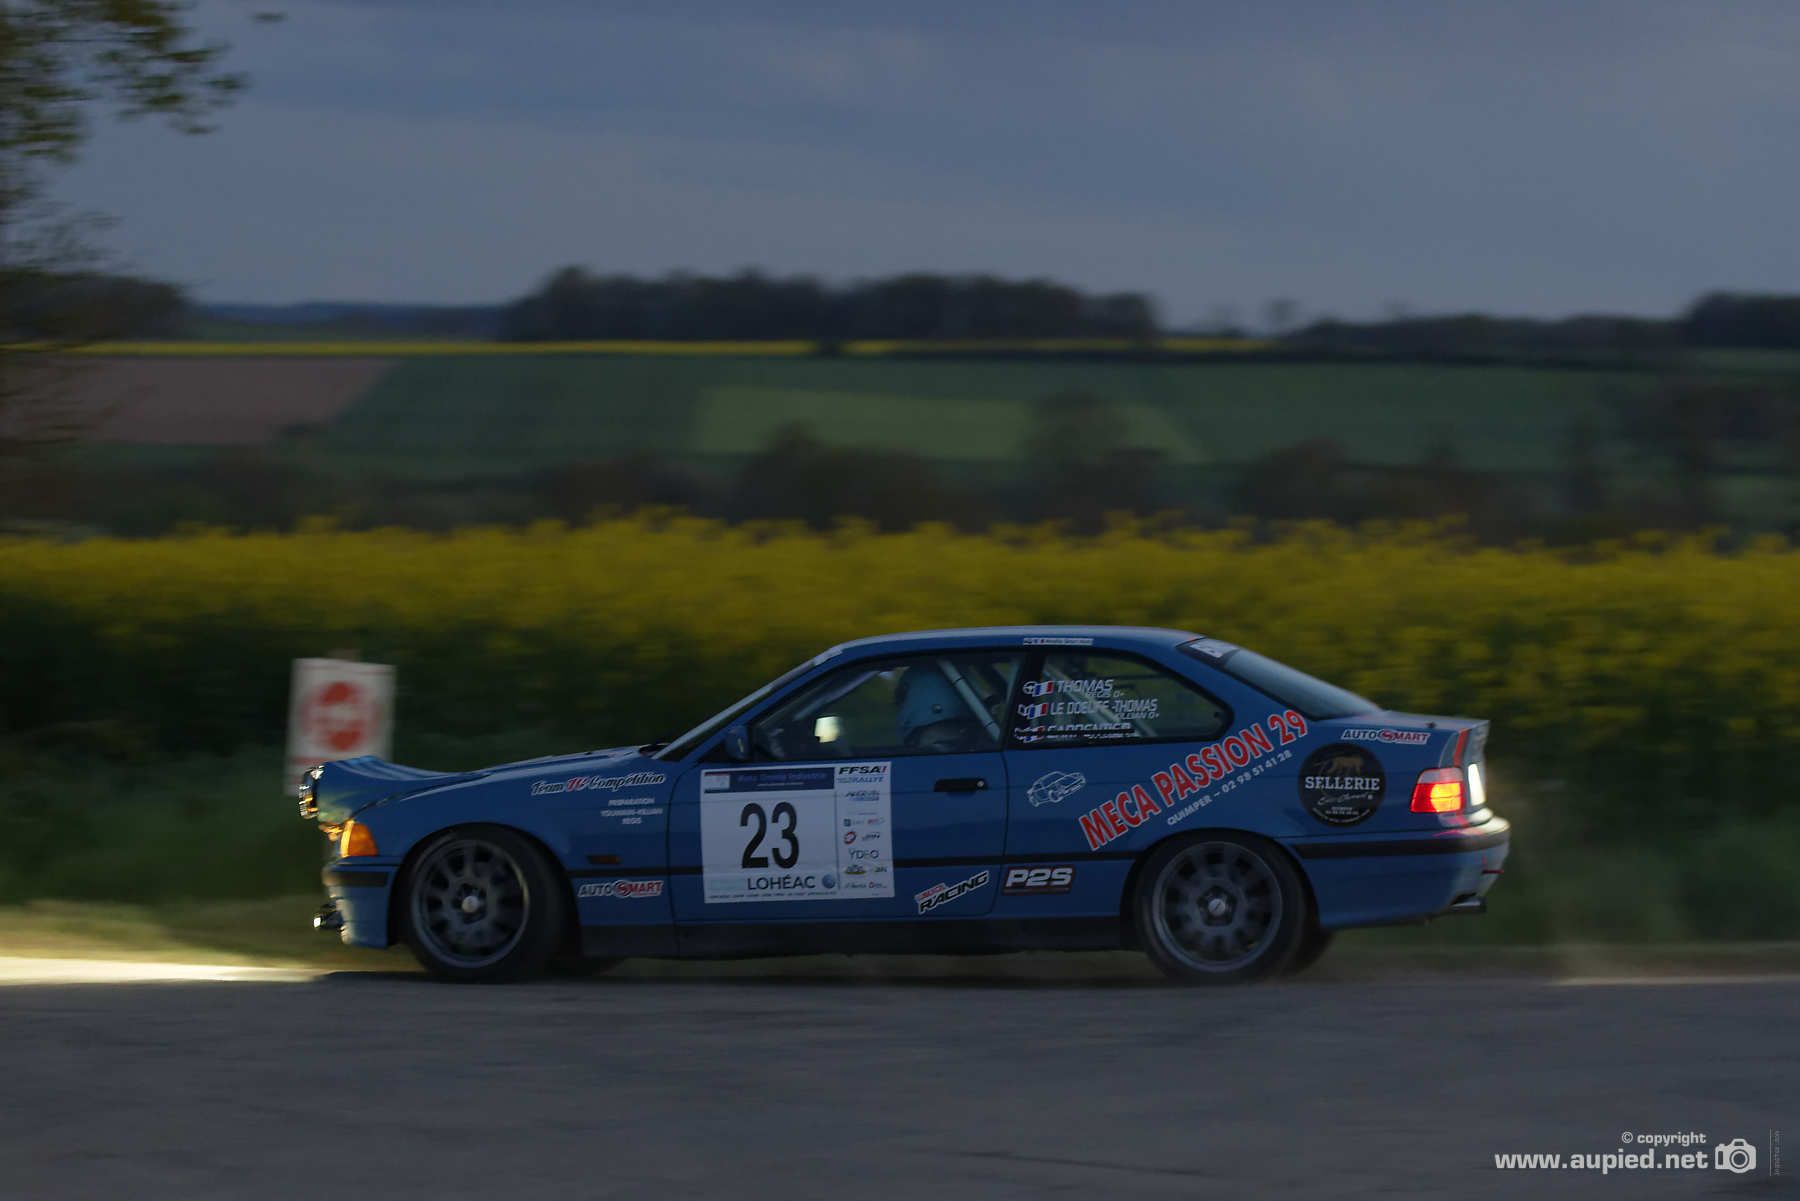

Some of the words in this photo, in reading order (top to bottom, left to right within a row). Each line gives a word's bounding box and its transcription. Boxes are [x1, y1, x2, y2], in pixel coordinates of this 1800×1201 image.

[1058, 679, 1114, 693] THOMAS
[1050, 701, 1065, 715] LE
[532, 780, 565, 796] Team
[1079, 784, 1162, 851] MECA
[1151, 722, 1275, 808] PASSION
[1267, 709, 1308, 746] 29
[1304, 775, 1381, 791] SELLERIE
[1167, 794, 1212, 826] QUIMPER
[1222, 780, 1237, 794] 02
[1238, 770, 1252, 786] 98
[1253, 764, 1265, 777] 51
[1265, 756, 1279, 769] 41
[739, 801, 799, 869] 23
[747, 875, 816, 891] LOHÉAC
[1005, 867, 1074, 888] P2S
[918, 870, 990, 915] RACING
